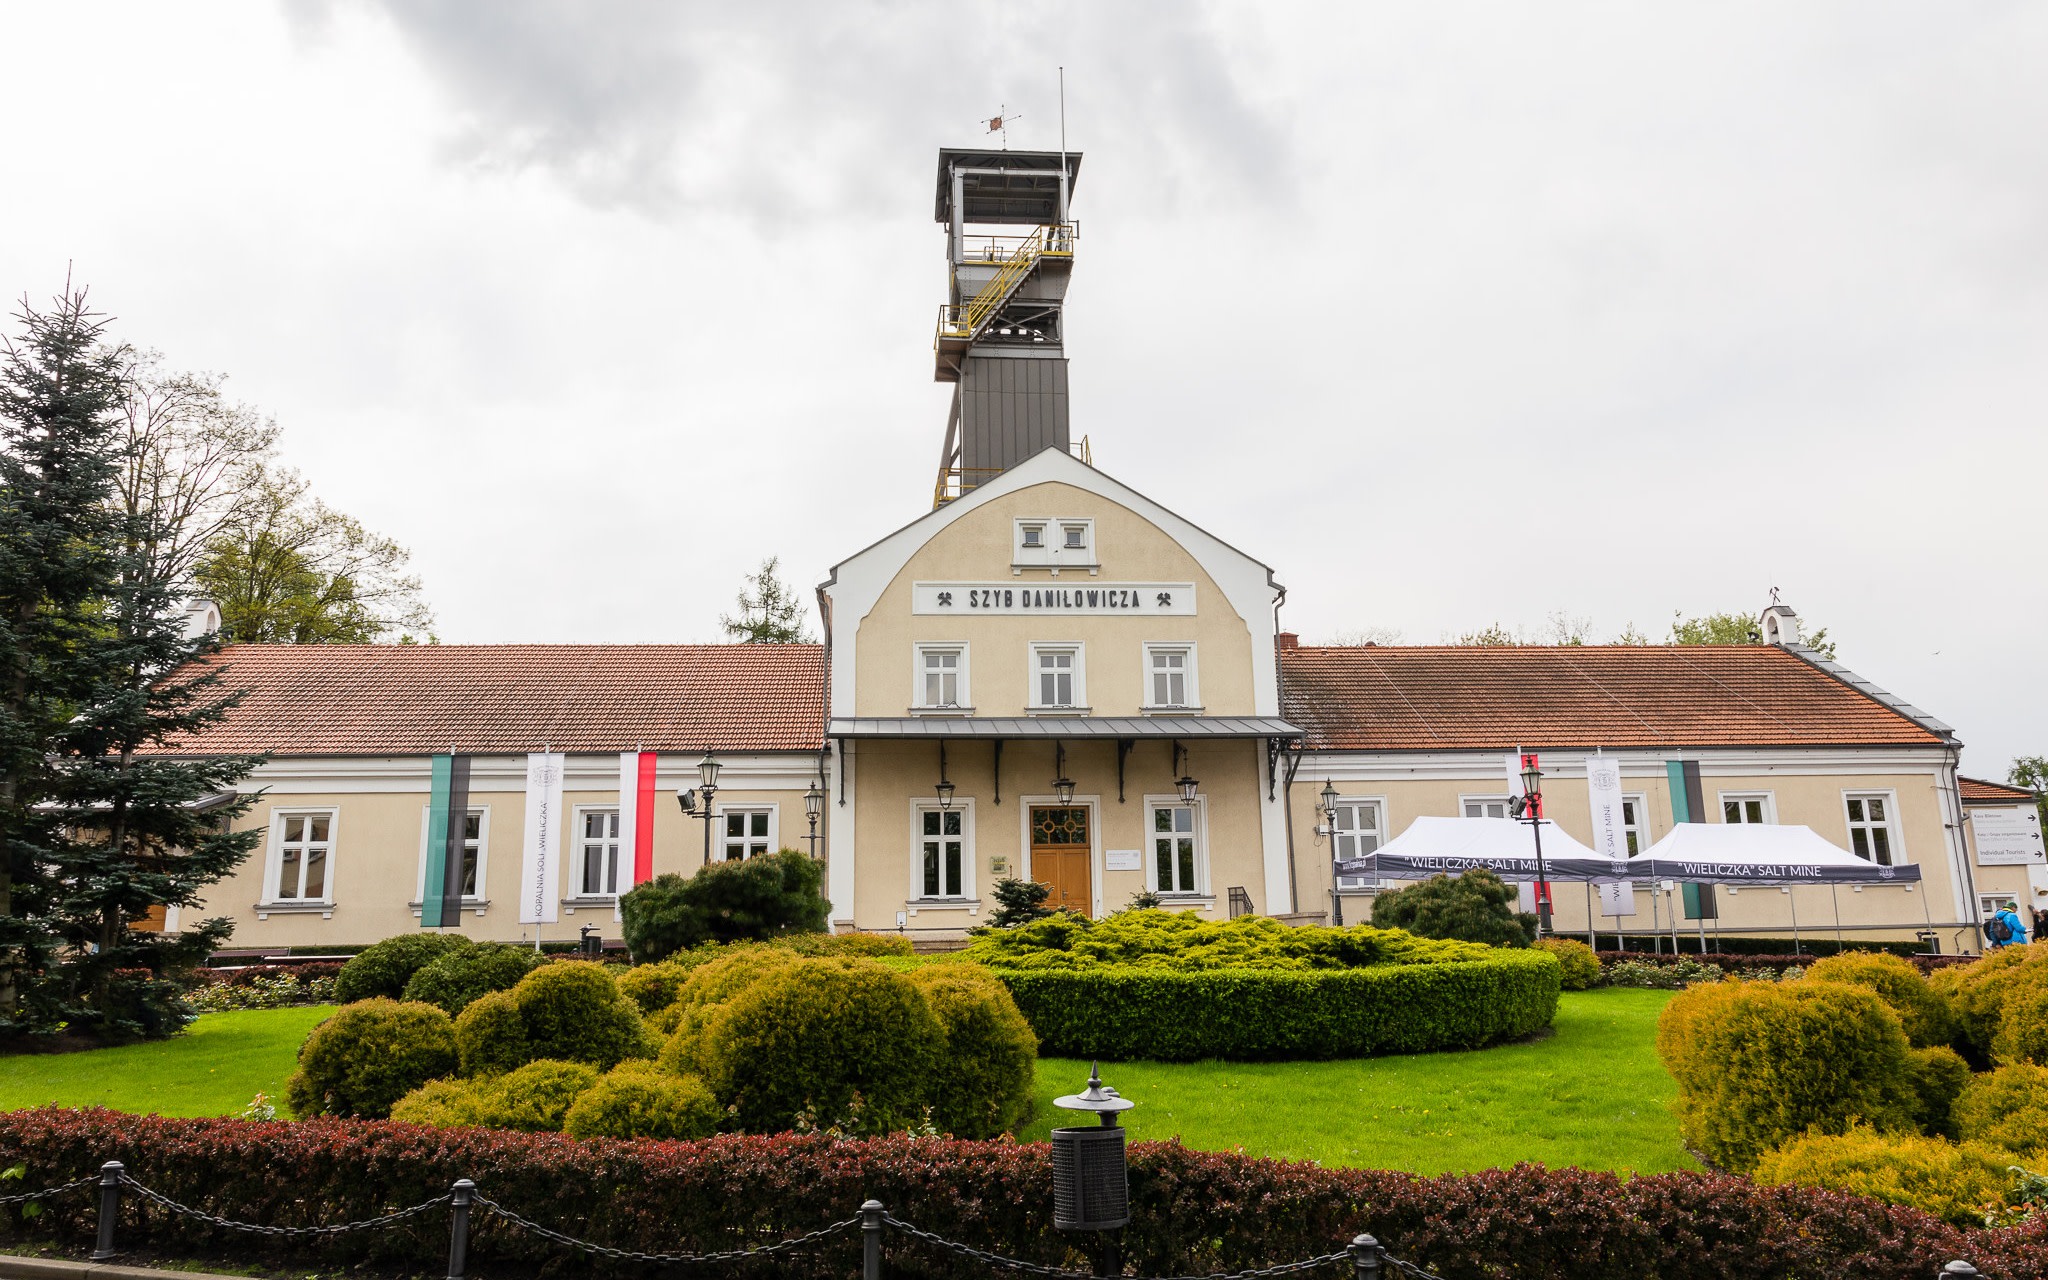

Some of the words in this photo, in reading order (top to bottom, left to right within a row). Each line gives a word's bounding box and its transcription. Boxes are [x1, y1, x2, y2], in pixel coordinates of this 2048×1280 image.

[970, 589, 1013, 608] SZYB
[1022, 589, 1140, 608] DANIŁOWICZA
[1603, 804, 1611, 826] MINE
[1605, 828, 1615, 848] SALT
[537, 853, 545, 872] SOLI
[1487, 859, 1517, 870] SALT
[1758, 865, 1786, 876] SALT
[1790, 866, 1822, 877] MINE
[535, 873, 544, 917] KOPALNIA
